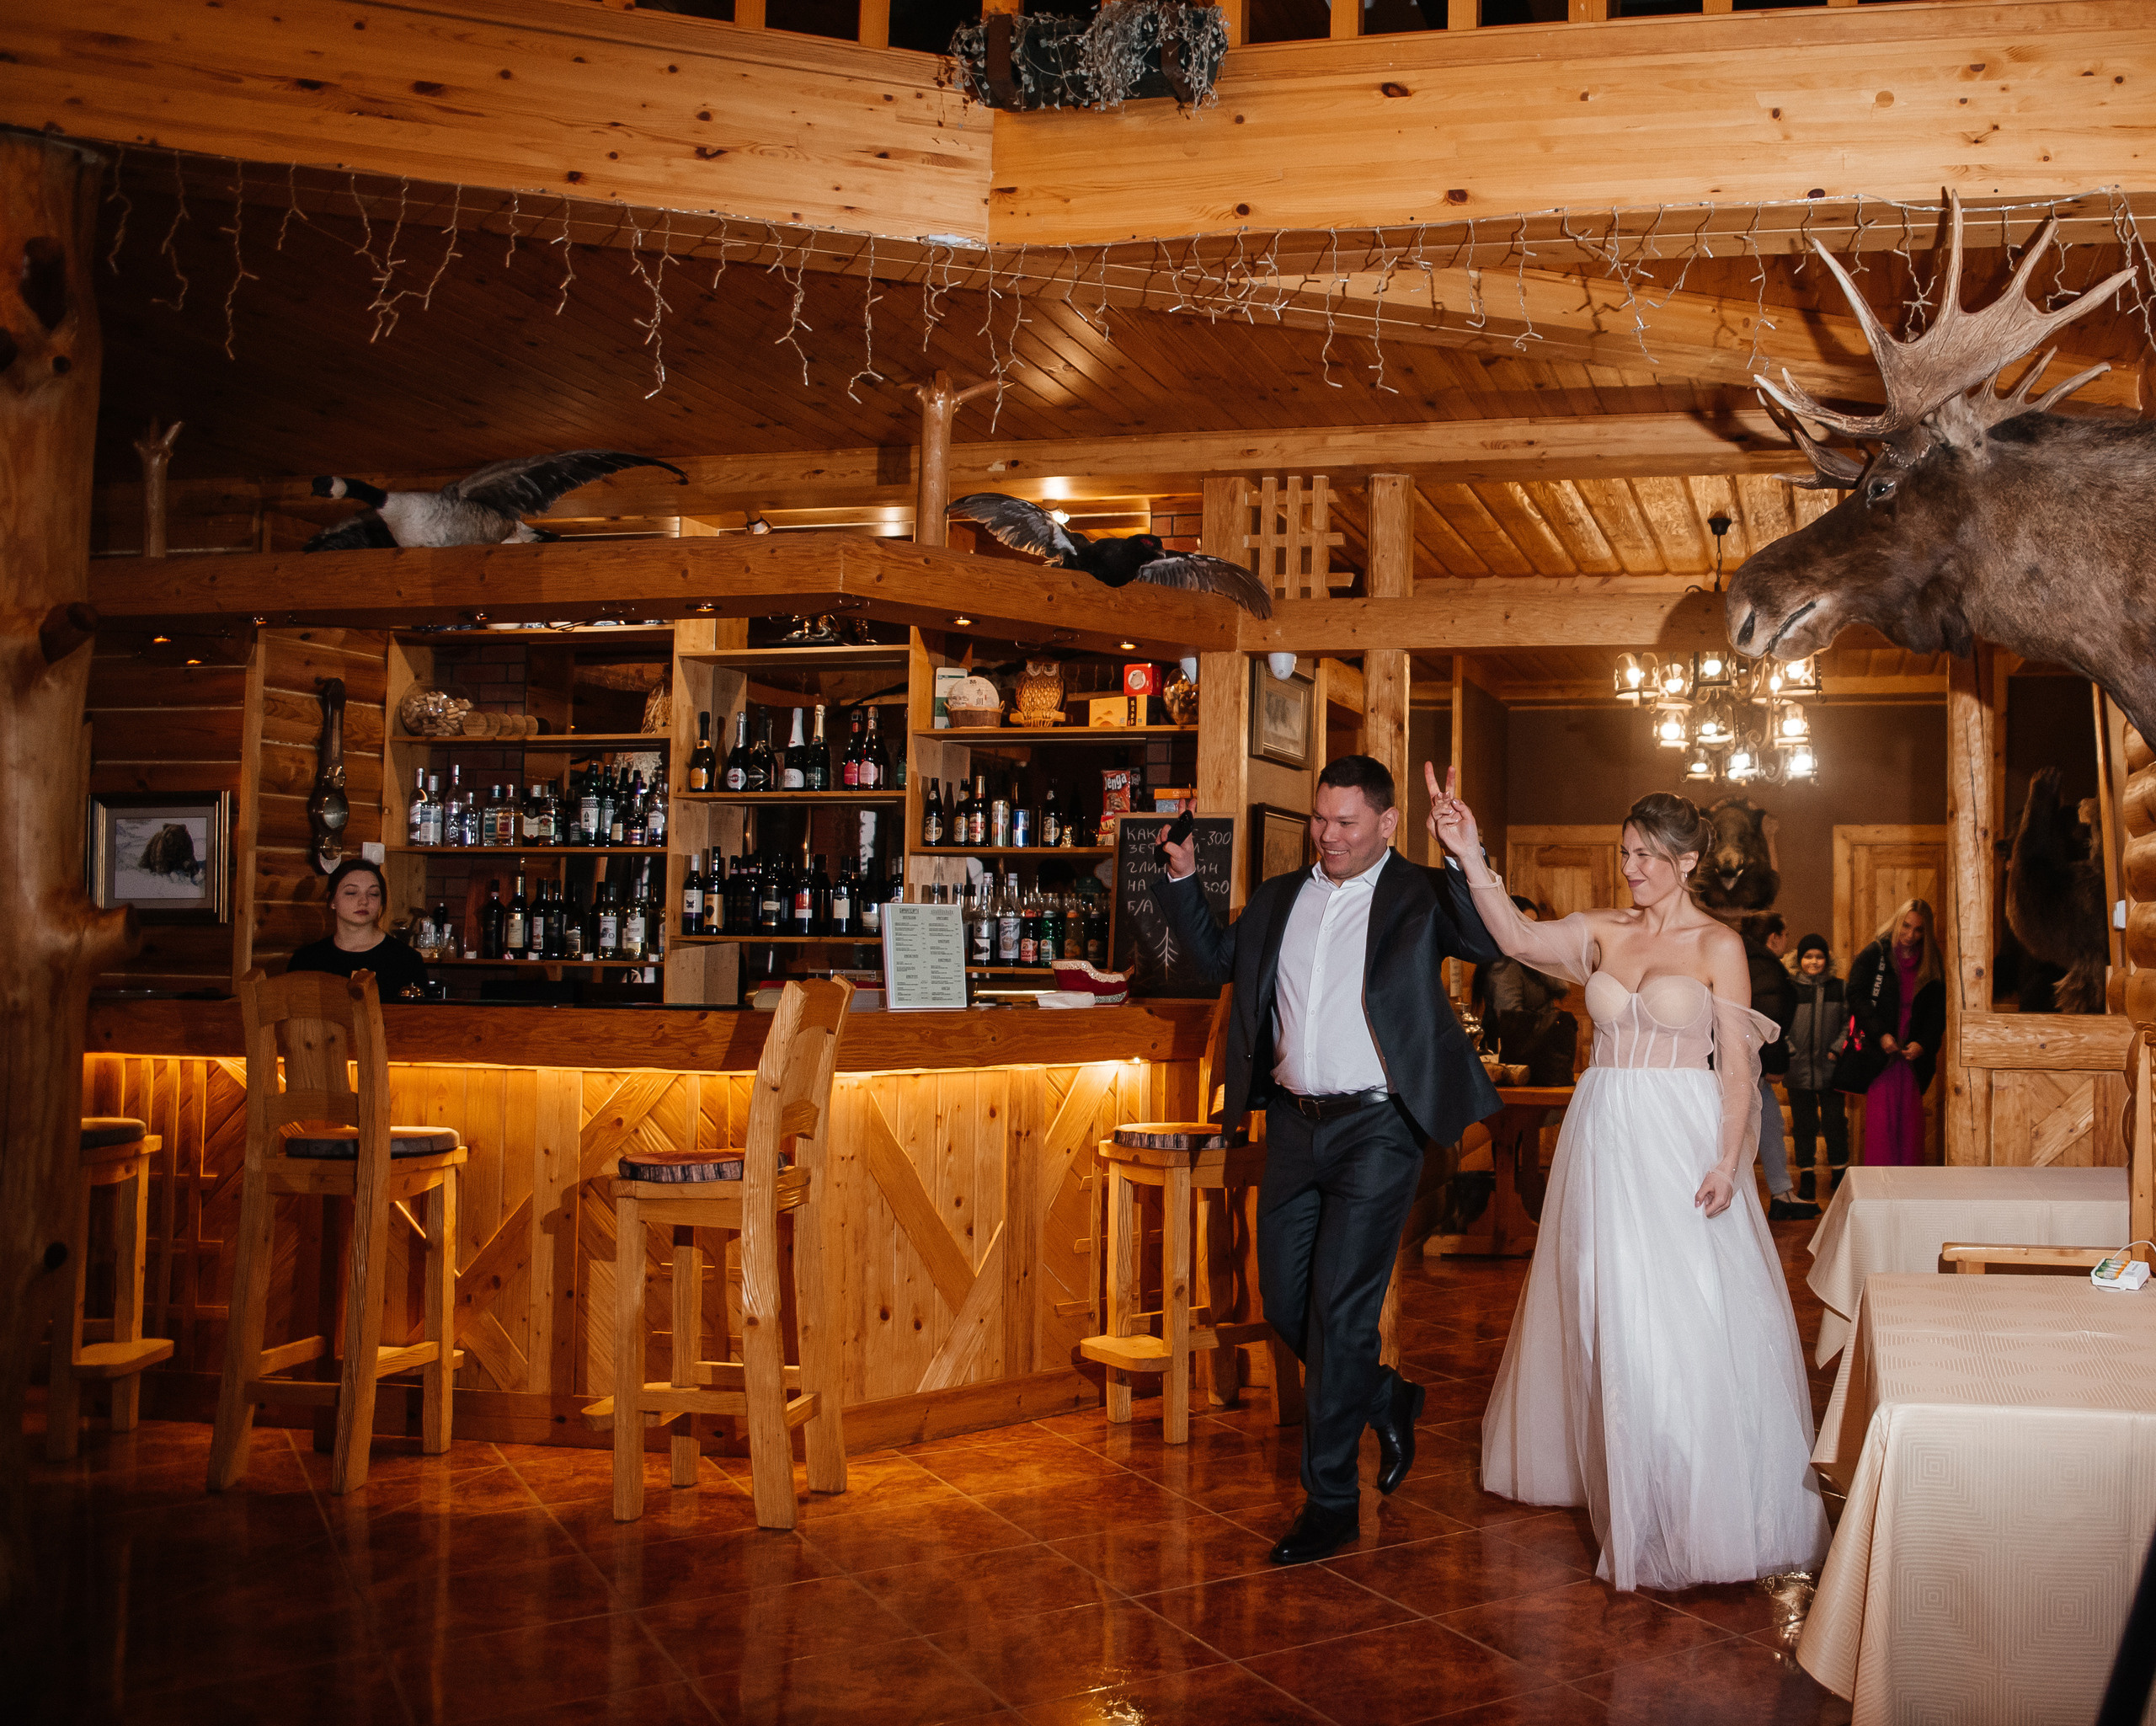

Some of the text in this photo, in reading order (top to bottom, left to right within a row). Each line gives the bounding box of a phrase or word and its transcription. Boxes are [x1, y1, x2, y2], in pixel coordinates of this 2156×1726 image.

[1104, 772, 1128, 791] Jenga
[1128, 879, 1230, 894] НА 300
